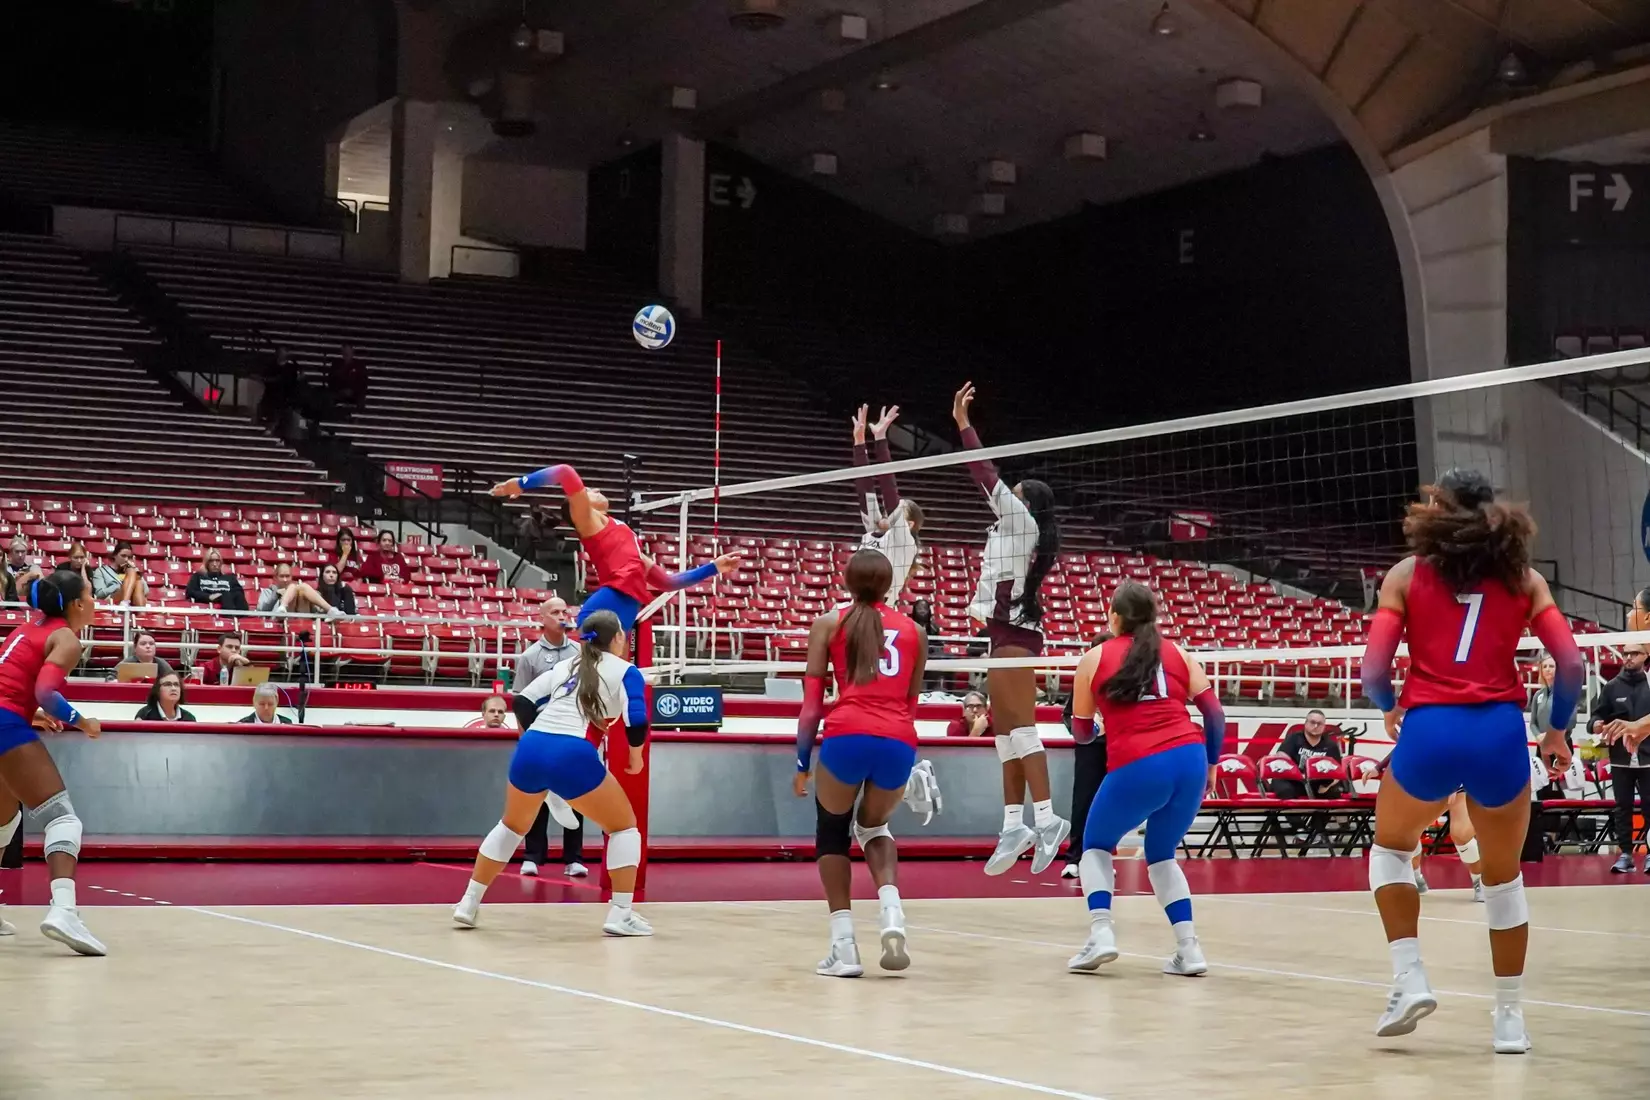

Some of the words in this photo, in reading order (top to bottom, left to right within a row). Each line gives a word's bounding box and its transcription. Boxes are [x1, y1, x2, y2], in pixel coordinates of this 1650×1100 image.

[709, 173, 732, 206] E
[1569, 172, 1596, 212] F
[1179, 229, 1195, 264] E
[1454, 593, 1484, 662] 7
[878, 628, 900, 677] 3
[659, 696, 679, 716] SEC
[682, 696, 714, 706] VIDEO
[682, 705, 715, 714] REVIEW
